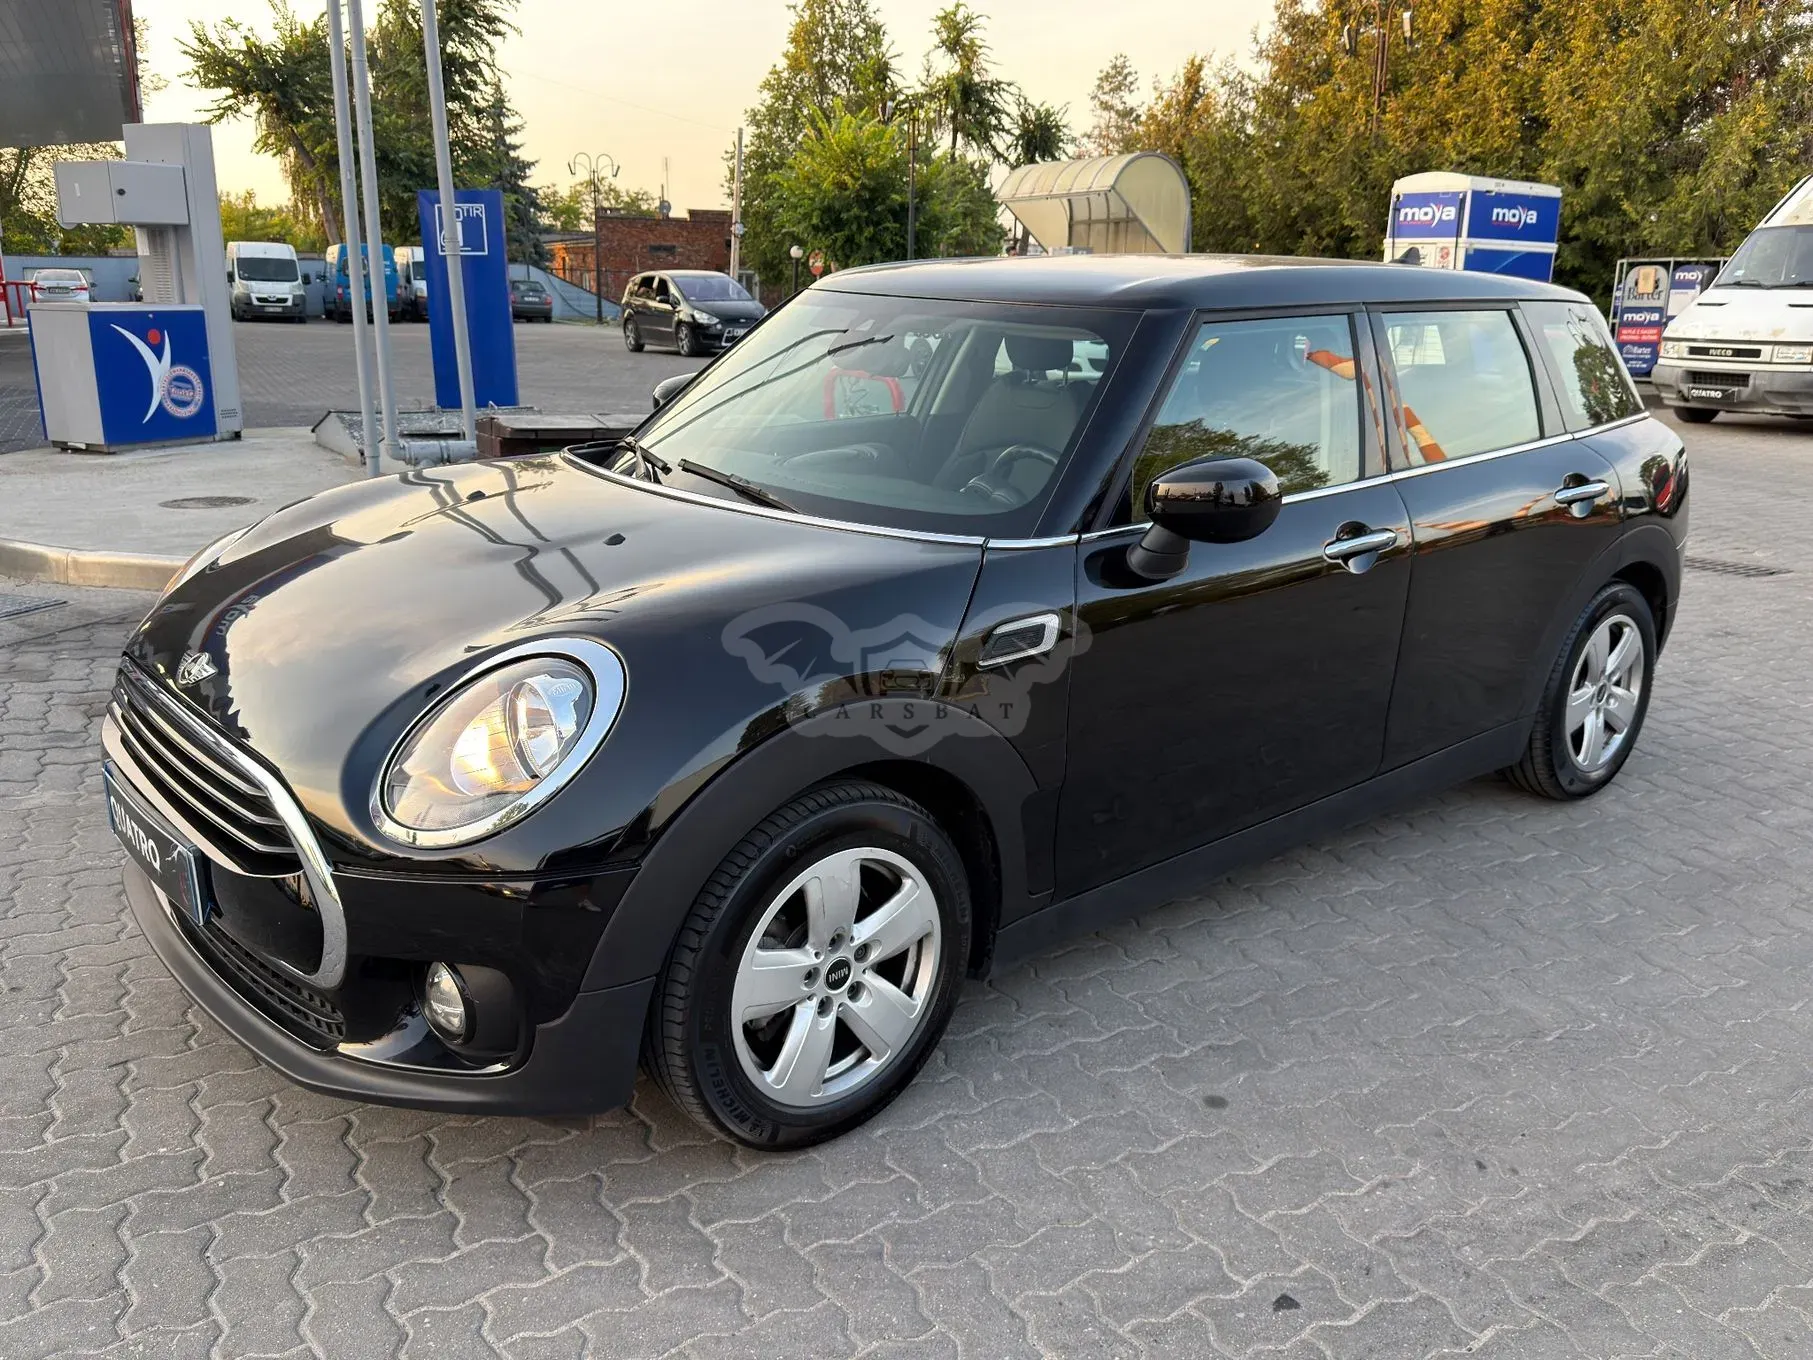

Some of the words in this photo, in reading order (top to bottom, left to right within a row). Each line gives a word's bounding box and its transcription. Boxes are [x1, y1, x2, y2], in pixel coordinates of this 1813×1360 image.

[461, 206, 483, 218] TIR
[1400, 203, 1455, 227] moya
[1492, 205, 1538, 230] moya
[1623, 311, 1660, 325] moya
[1709, 349, 1734, 357] IVECO
[1690, 388, 1723, 399] QUATRO
[110, 795, 162, 874] QUATRO
[829, 966, 849, 983] MINI
[703, 1047, 751, 1126] MICHELIN
